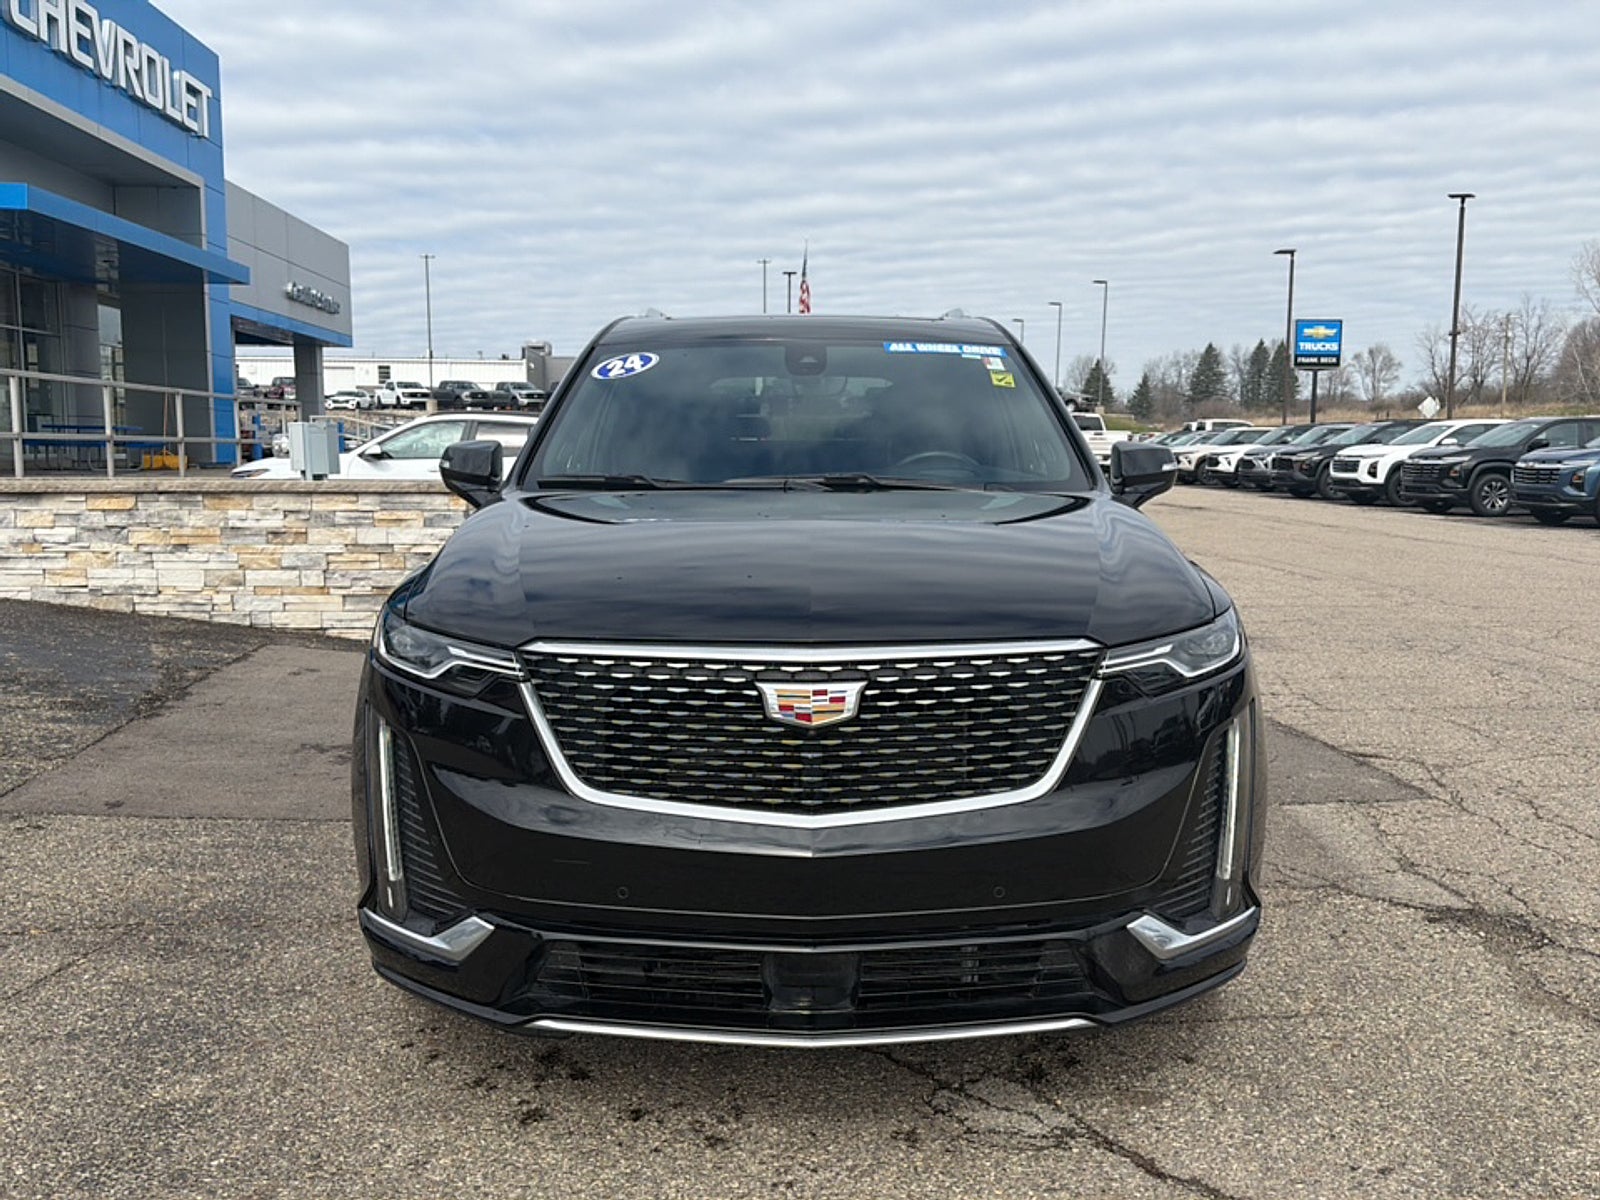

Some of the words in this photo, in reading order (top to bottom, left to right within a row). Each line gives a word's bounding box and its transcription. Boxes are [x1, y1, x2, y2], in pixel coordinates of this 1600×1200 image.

[889, 342, 914, 351] ALL
[916, 343, 960, 353] WHEEL
[961, 345, 1002, 356] DRIVE
[1299, 341, 1339, 351] TRUCKS
[606, 354, 643, 377] 24
